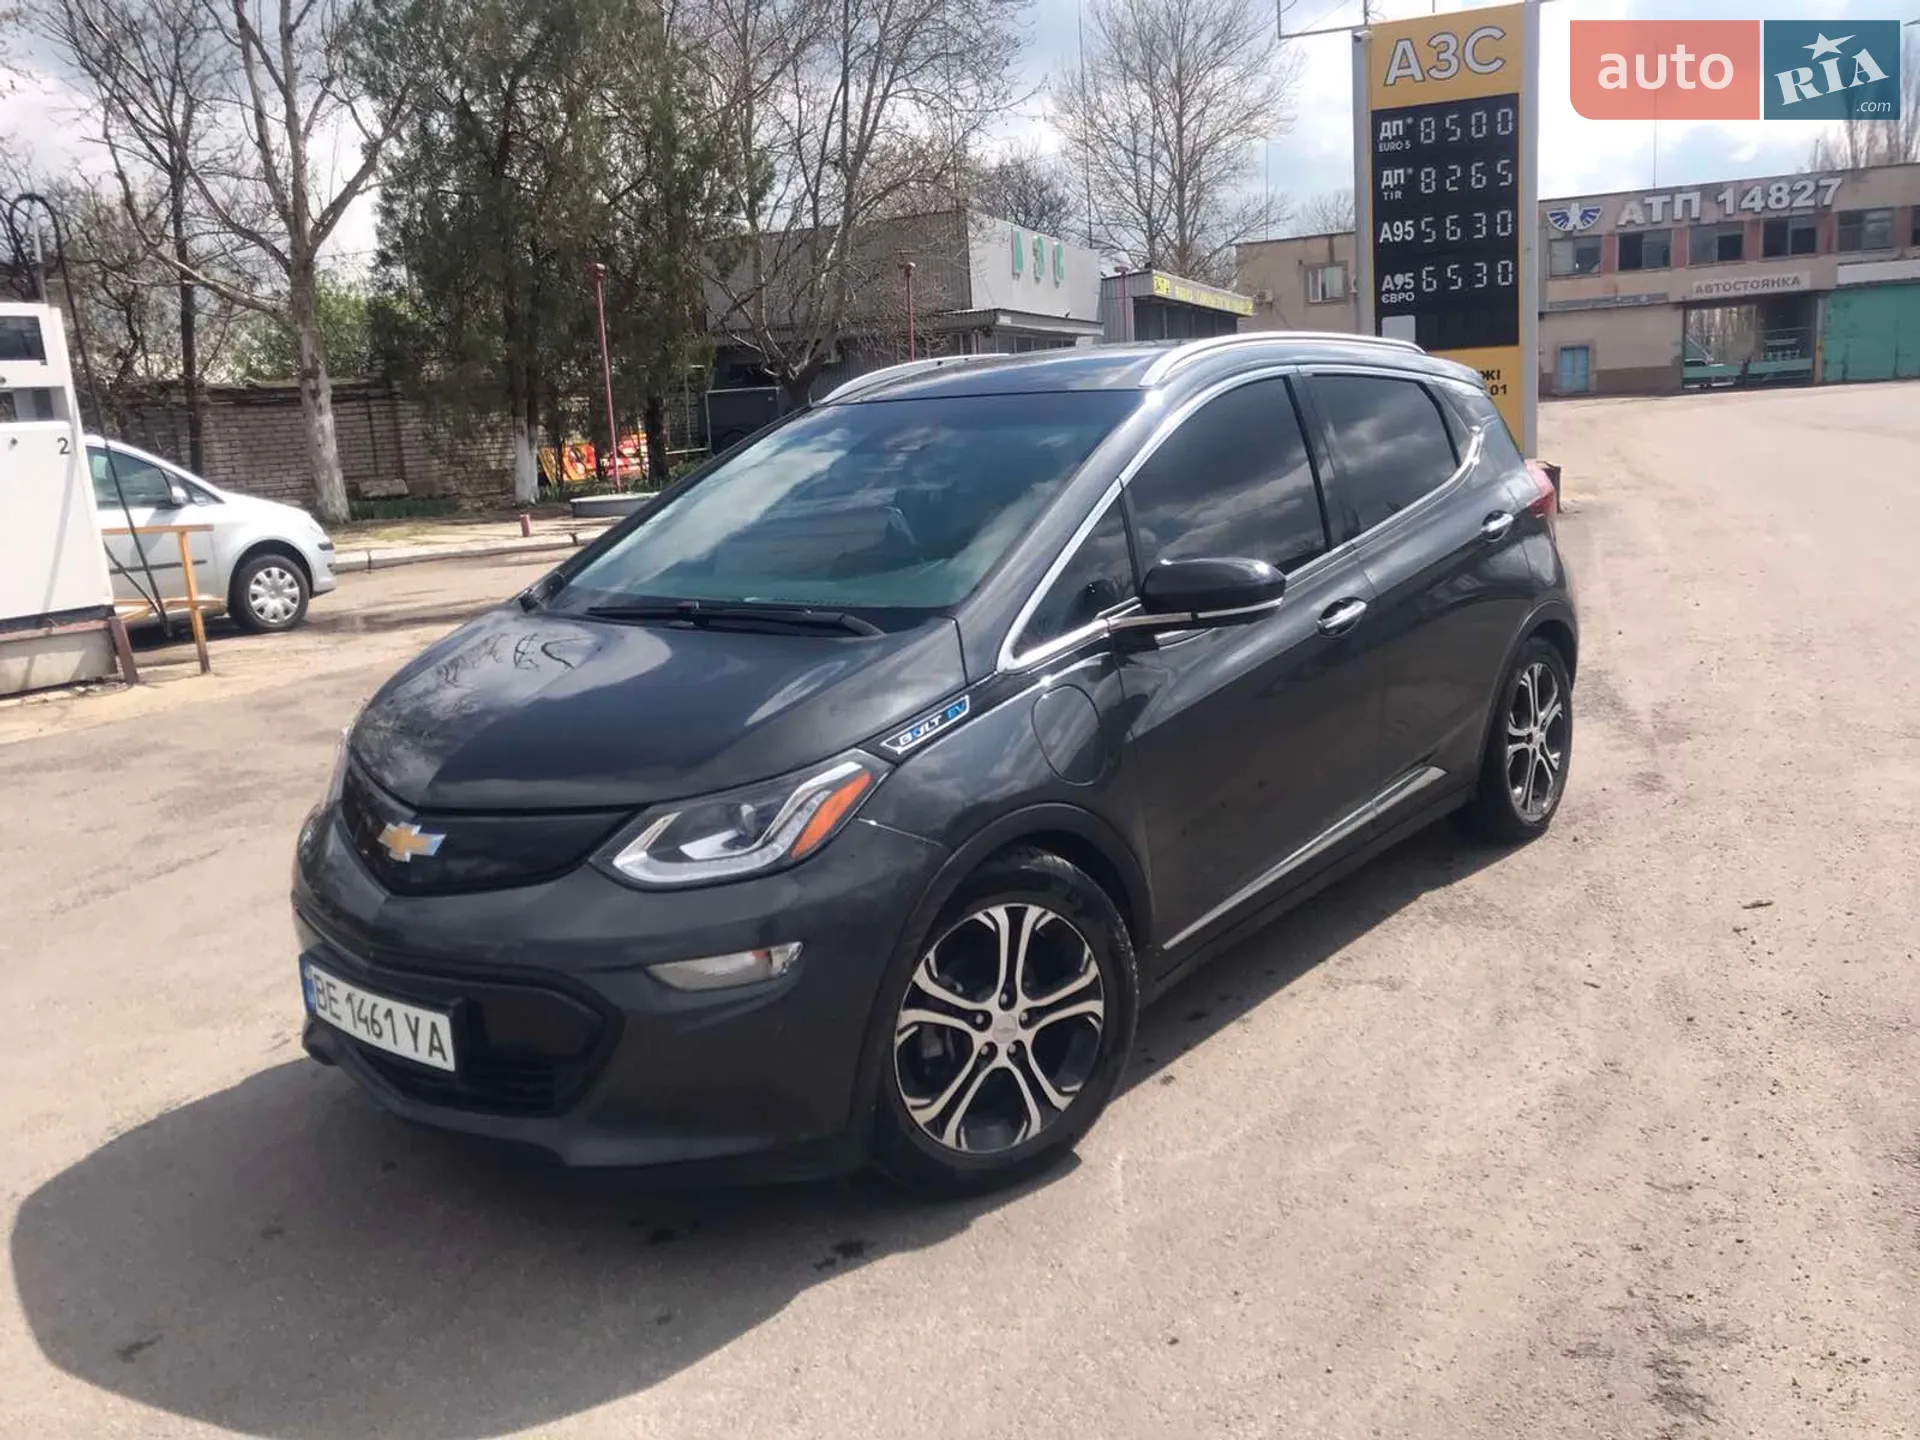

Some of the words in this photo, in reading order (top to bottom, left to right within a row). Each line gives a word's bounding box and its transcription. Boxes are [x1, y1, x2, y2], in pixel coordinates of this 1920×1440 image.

[1384, 26, 1506, 86] АЗС
[1420, 107, 1513, 144] 8500
[1378, 142, 1403, 152] EURO
[1420, 159, 1513, 194] 8265
[1383, 191, 1402, 200] TIR
[1616, 191, 1701, 227] АТП
[1716, 177, 1843, 215] 14827
[1379, 220, 1415, 243] А95
[1421, 210, 1512, 243] 5630
[1422, 260, 1513, 292] 6530
[1695, 275, 1801, 295] АВТОСТОЯНКА
[57, 437, 70, 455] 2
[313, 974, 342, 1022] BE
[345, 992, 398, 1046] 1461
[404, 1012, 448, 1062] YA
